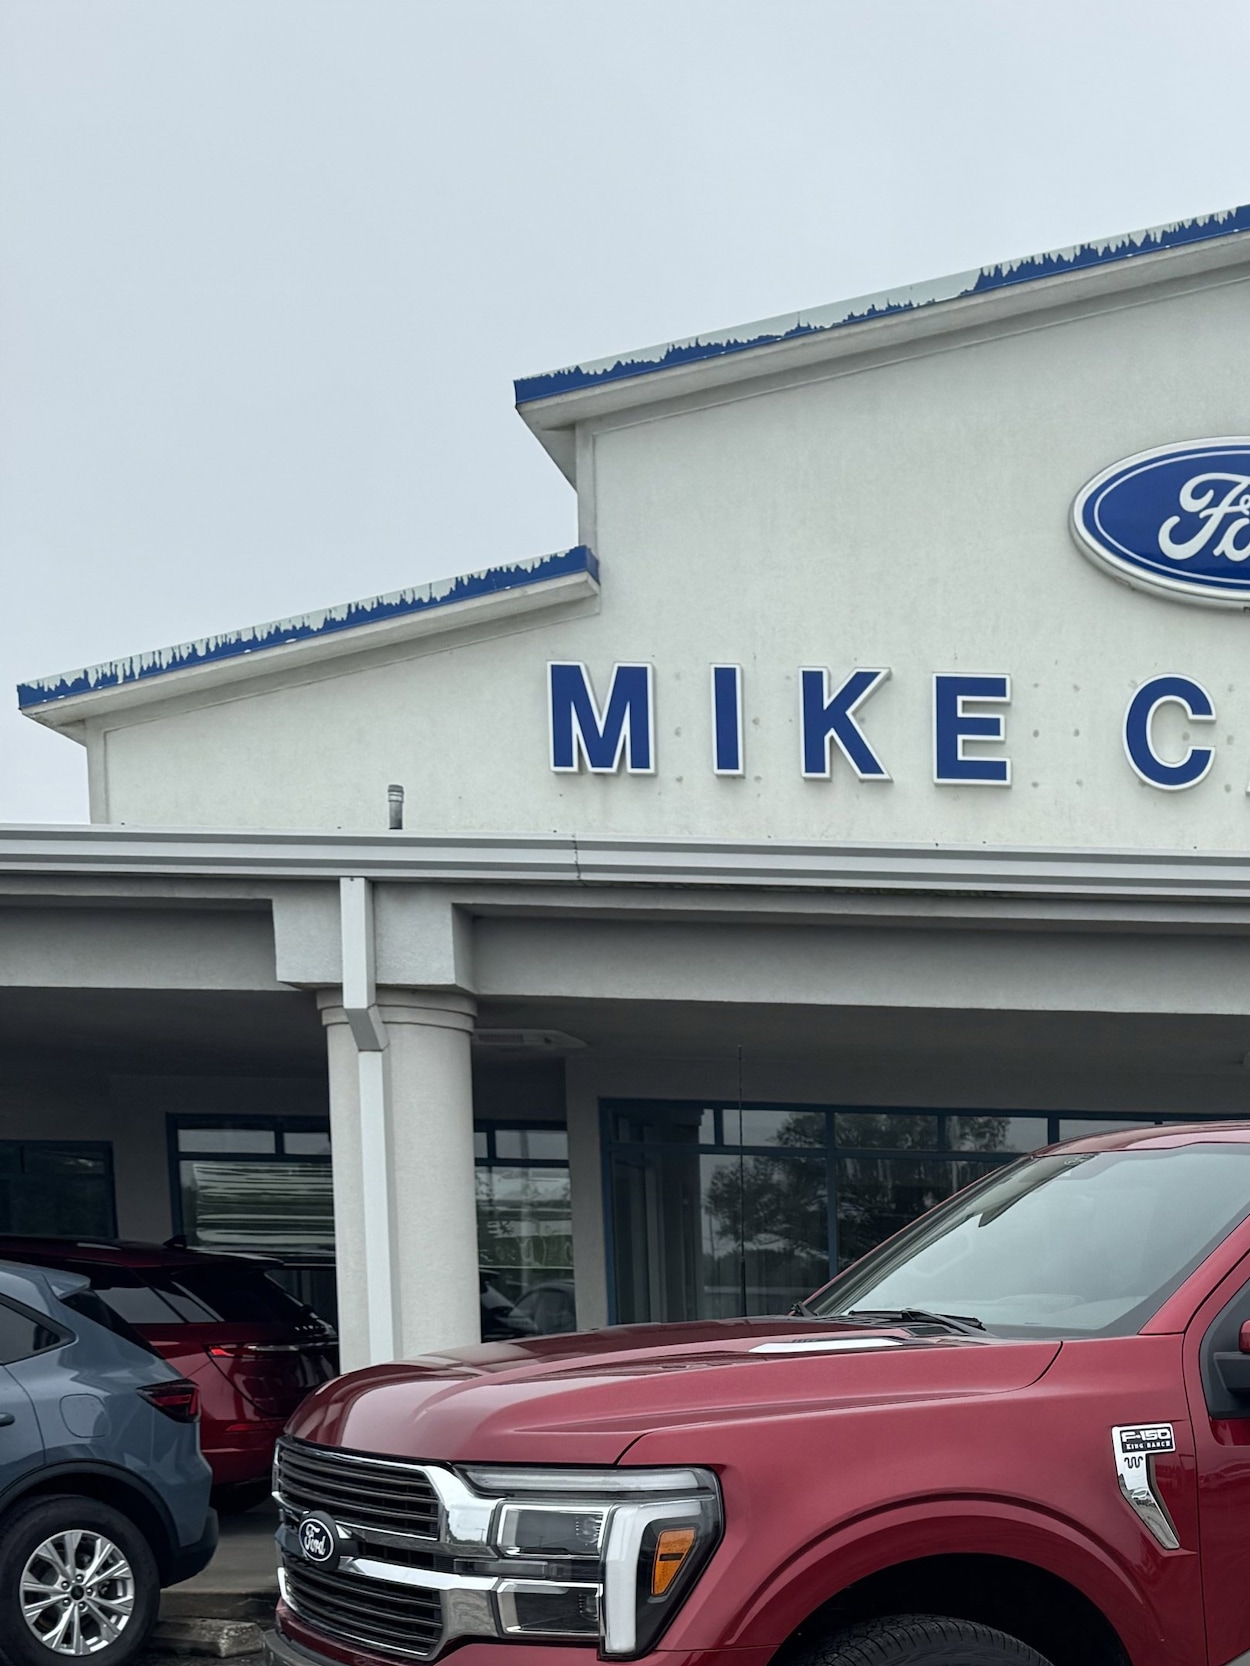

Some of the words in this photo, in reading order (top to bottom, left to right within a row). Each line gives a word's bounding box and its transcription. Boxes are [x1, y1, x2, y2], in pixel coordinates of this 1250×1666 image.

[547, 659, 1012, 787] MIKE
[1121, 1428, 1171, 1442] F-150
[304, 1523, 326, 1556] Ford
